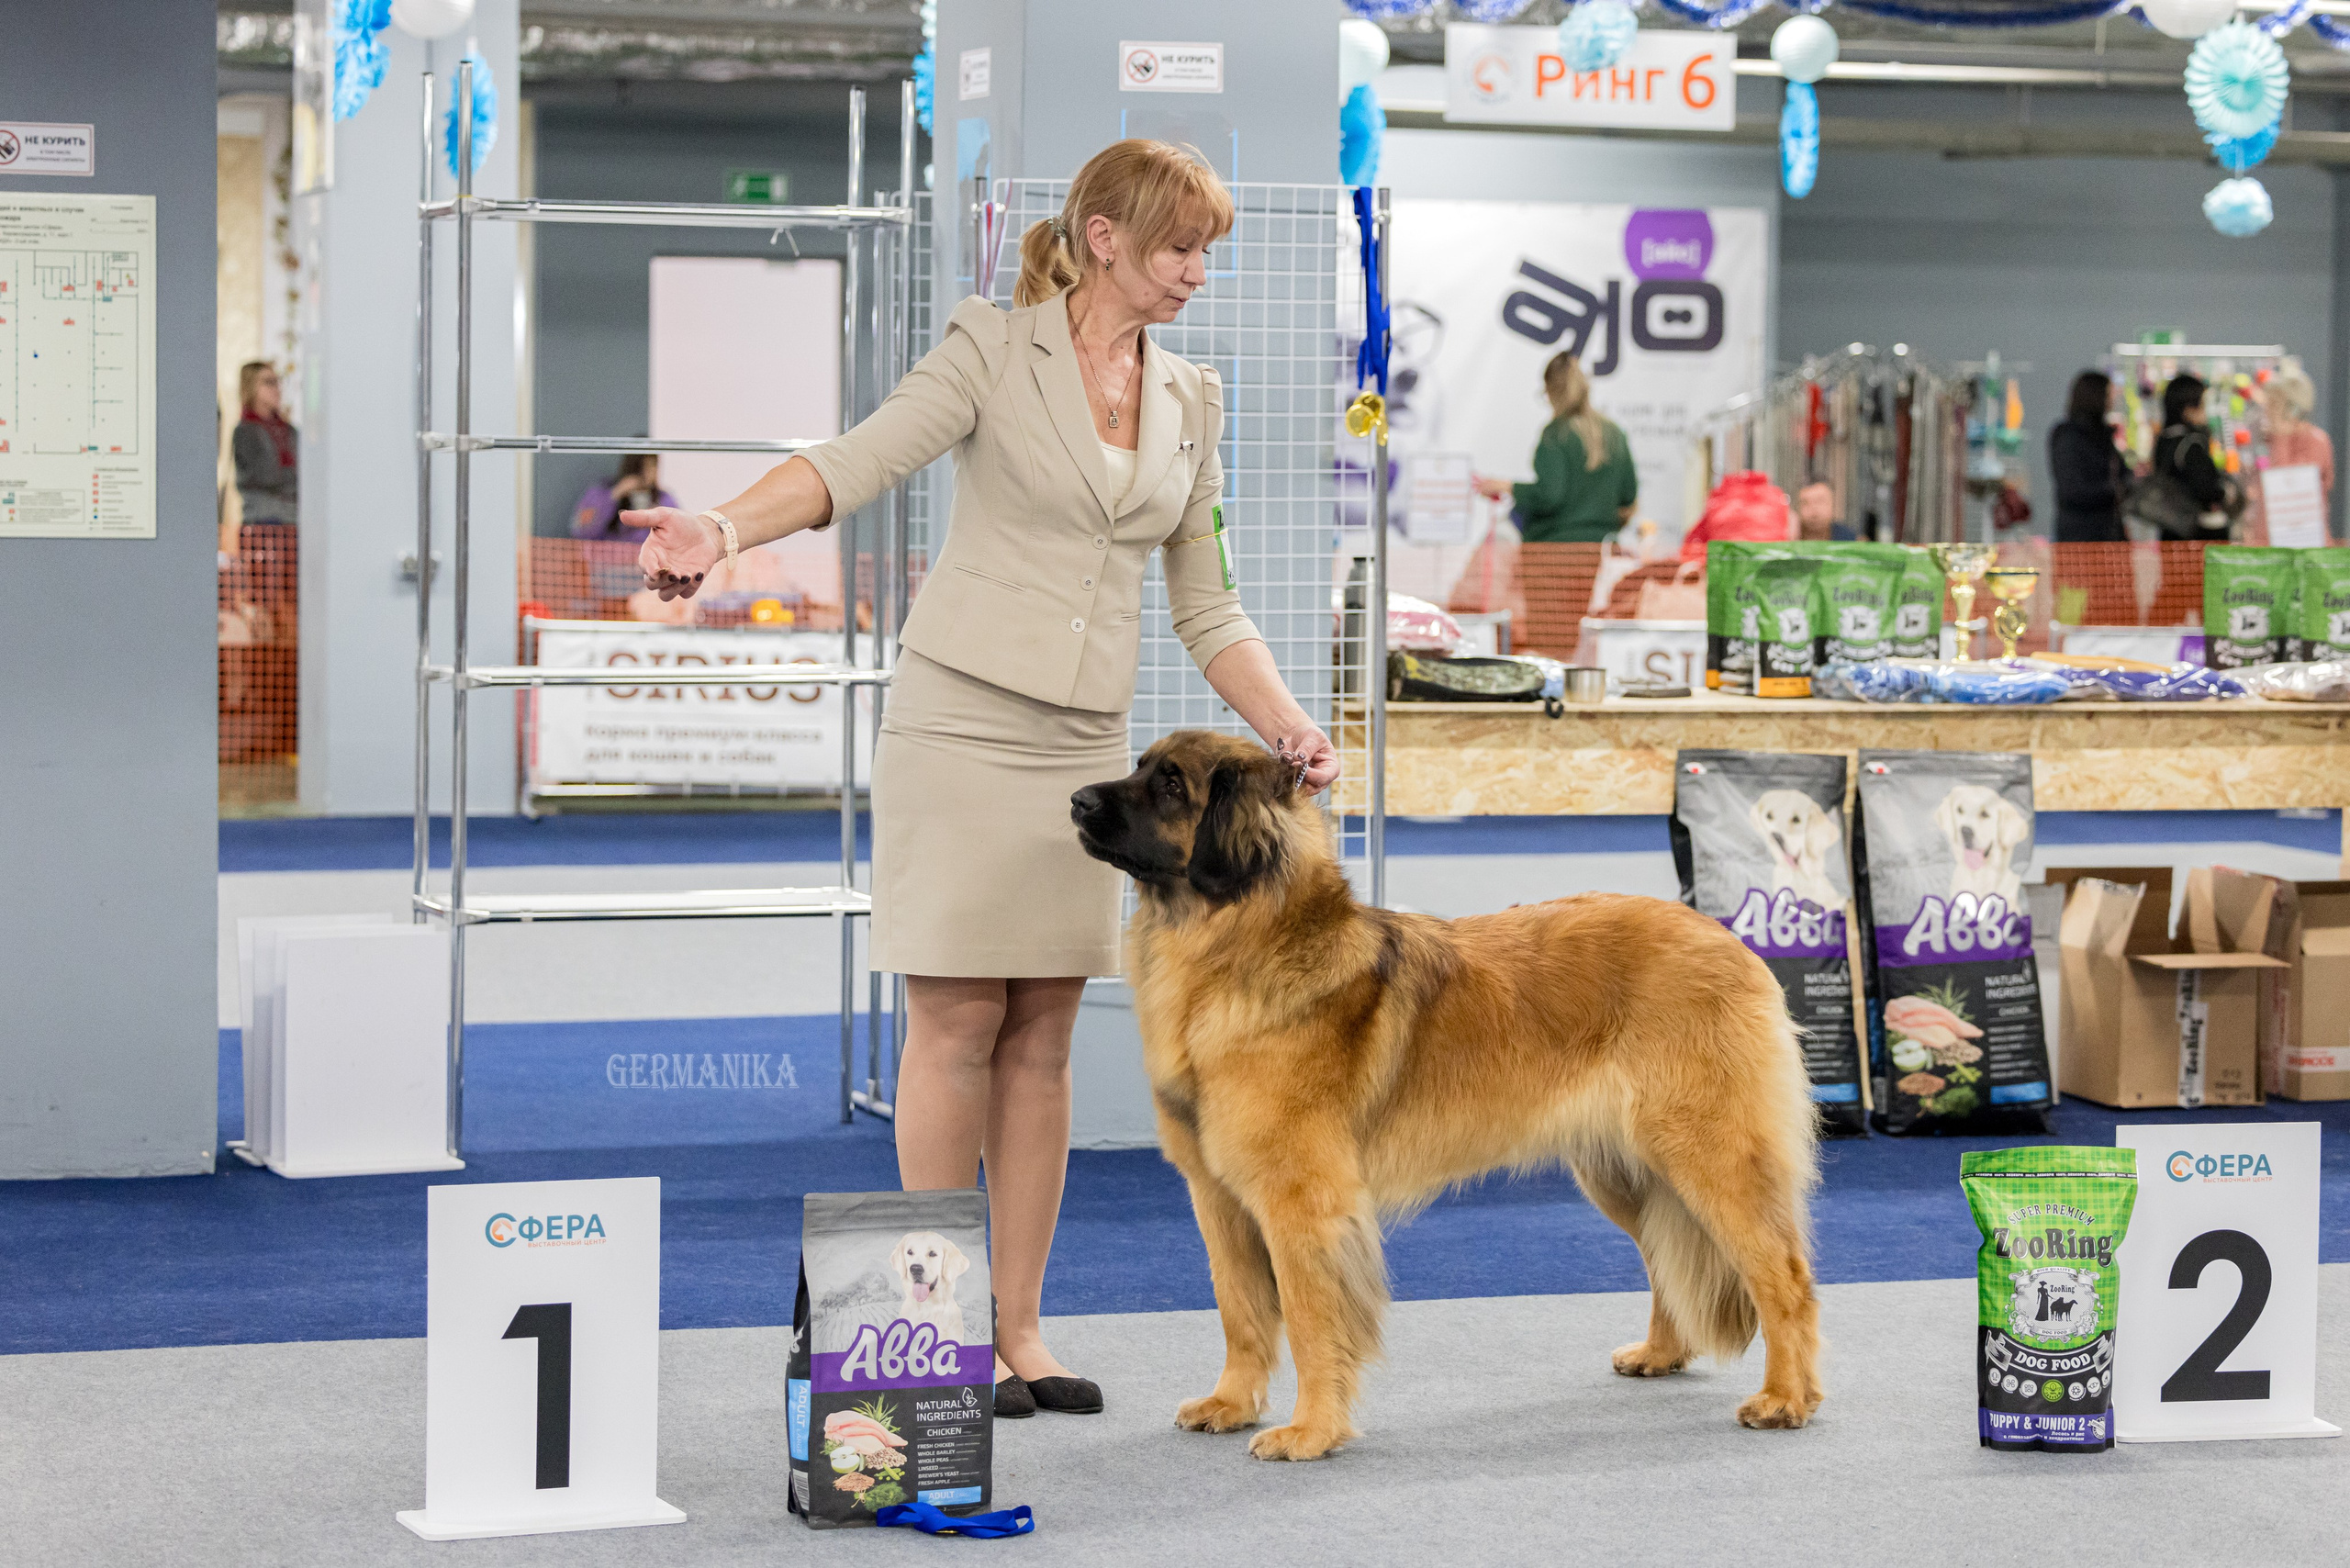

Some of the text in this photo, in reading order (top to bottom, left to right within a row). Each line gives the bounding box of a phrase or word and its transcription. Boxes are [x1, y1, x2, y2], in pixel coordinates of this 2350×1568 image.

[1536, 53, 1716, 109] Ринг 6
[25, 136, 86, 146] НЕ КУРИТЬ
[2165, 1150, 2273, 1182] СФЕРА
[2007, 1203, 2096, 1226] SUPER PREMIUM
[485, 1212, 607, 1249] СФЕРА
[527, 1238, 607, 1249] ВЫСТАВОЧНЫЙ ЦЕНТР
[1993, 1227, 2113, 1268] ZooRing
[2050, 1284, 2076, 1294] ZooRing
[2160, 1228, 2273, 1404] 2
[2014, 1350, 2091, 1372] DOG FOOD
[500, 1302, 572, 1490] 1
[796, 1384, 808, 1428] ADULT
[916, 1399, 963, 1411] NATURAL
[916, 1408, 981, 1422] INGREDIENTS
[1989, 1413, 2020, 1429] PUPPY
[2023, 1416, 2032, 1430] &
[2035, 1417, 2076, 1431] JUNIOR
[2078, 1417, 2086, 1431] 2
[926, 1427, 962, 1438] CHICKEN
[928, 1490, 956, 1500] ADULT
